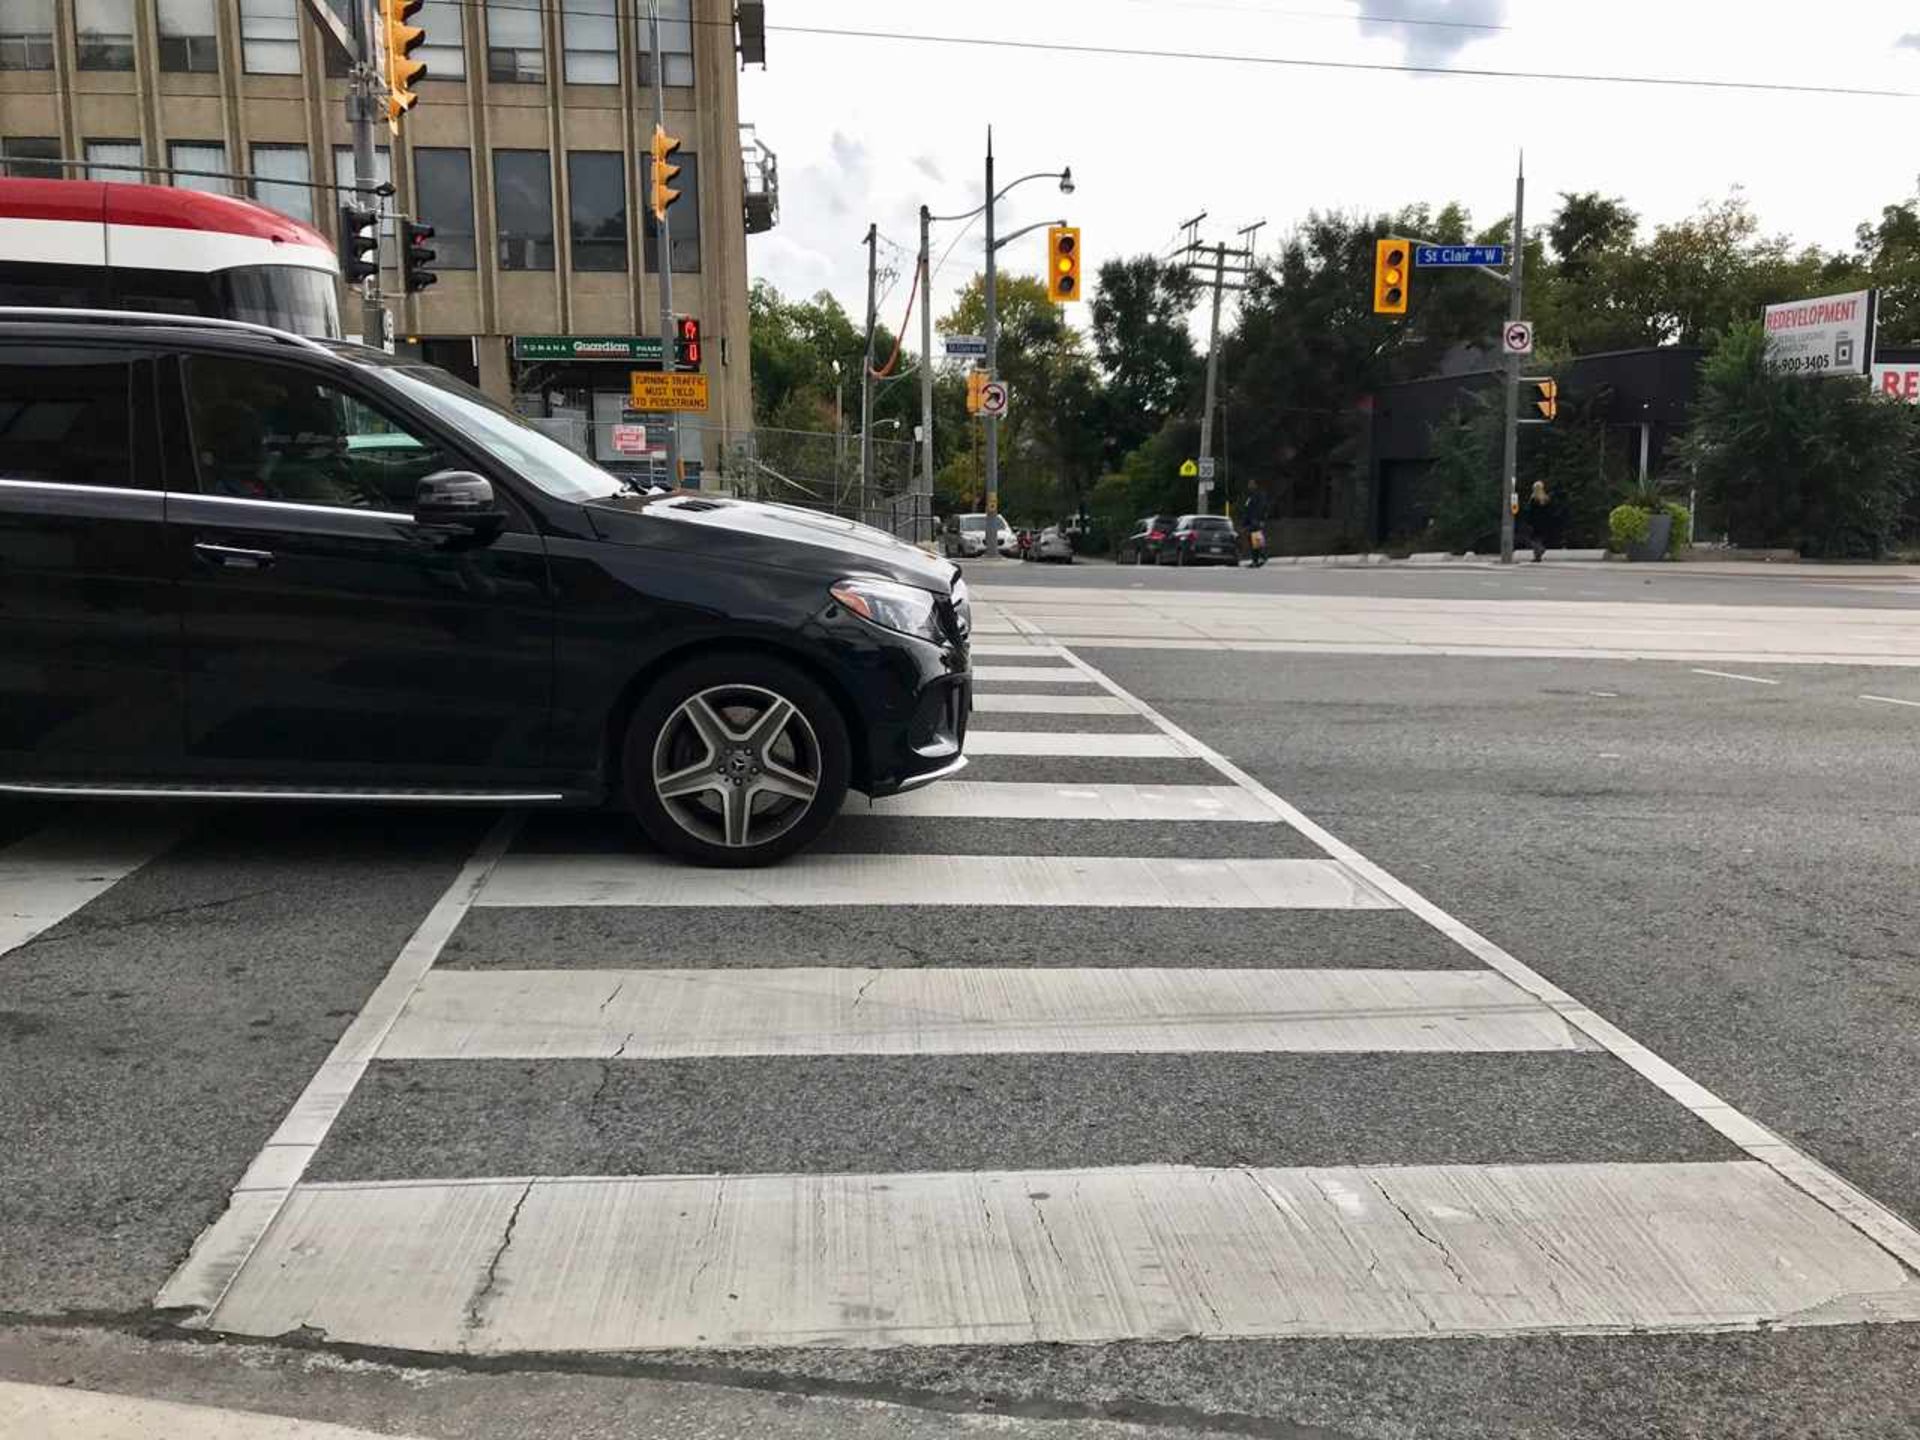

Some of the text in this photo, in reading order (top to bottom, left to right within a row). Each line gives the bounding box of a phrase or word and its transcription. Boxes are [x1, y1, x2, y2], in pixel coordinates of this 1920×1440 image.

[1425, 249, 1437, 262] St
[1442, 249, 1471, 262] Clair
[1485, 249, 1496, 262] W
[1766, 300, 1858, 331] REDEVELOPMENT
[573, 341, 630, 353] Guardian
[636, 375, 705, 386] TURNING TRAFFIC
[645, 387, 695, 397] MUST YIELD
[635, 398, 705, 407] TO PEDESTRIANS
